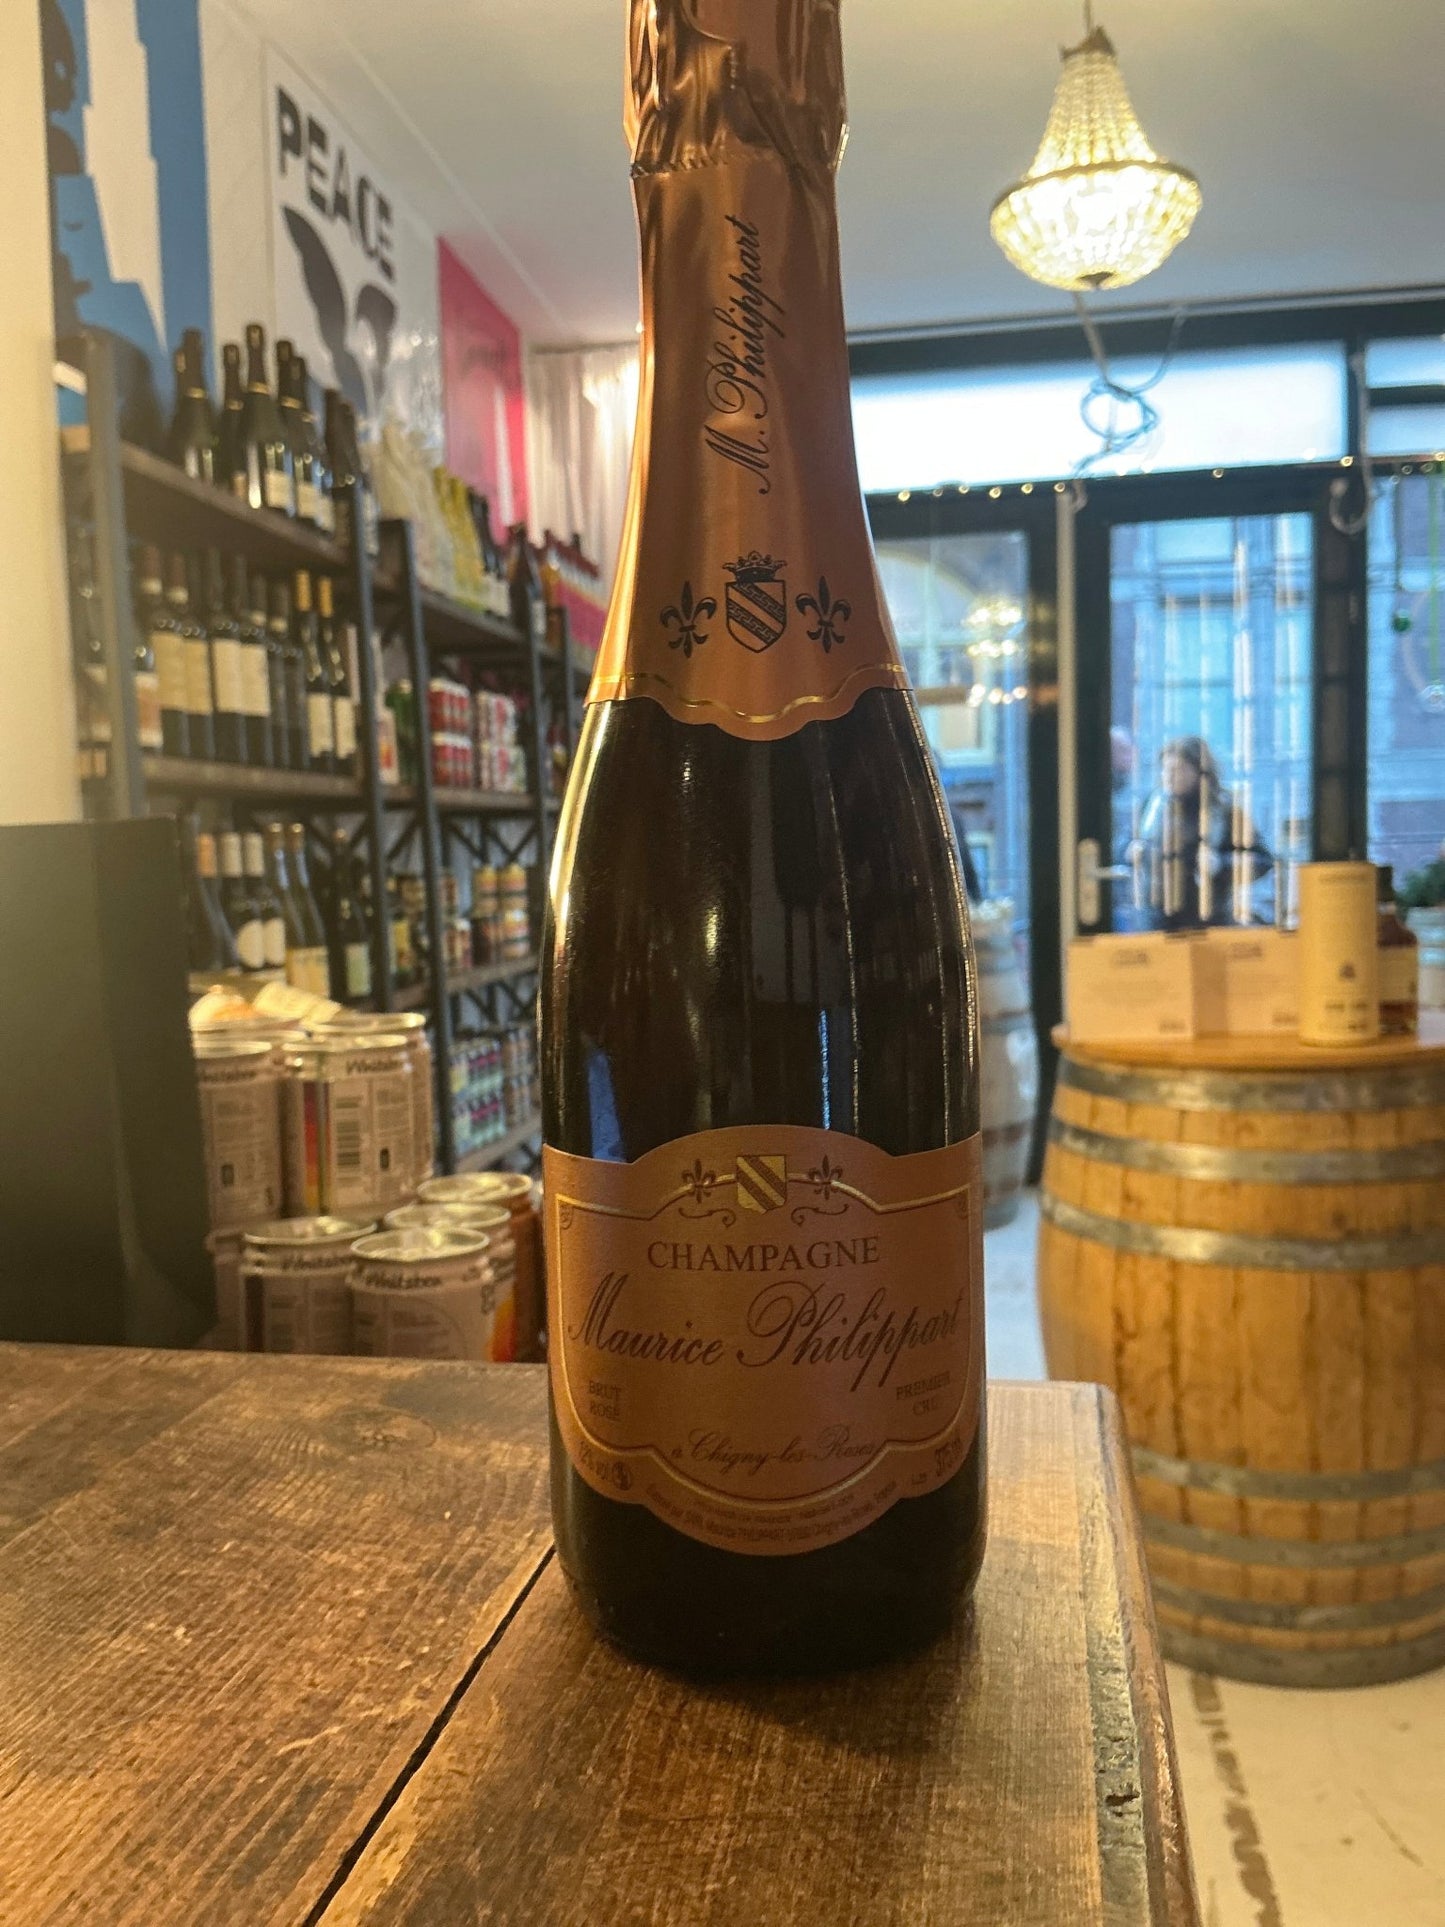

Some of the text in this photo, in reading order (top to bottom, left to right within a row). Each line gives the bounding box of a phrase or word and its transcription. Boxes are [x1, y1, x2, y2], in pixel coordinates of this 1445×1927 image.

[277, 85, 395, 280] PEACE
[704, 214, 785, 495] M. Philippart
[648, 1235, 880, 1272] CHAMPAGNE
[567, 1271, 965, 1392] Maurice Philippart
[589, 1380, 621, 1402] BRUT
[896, 1370, 950, 1401] PREMIER
